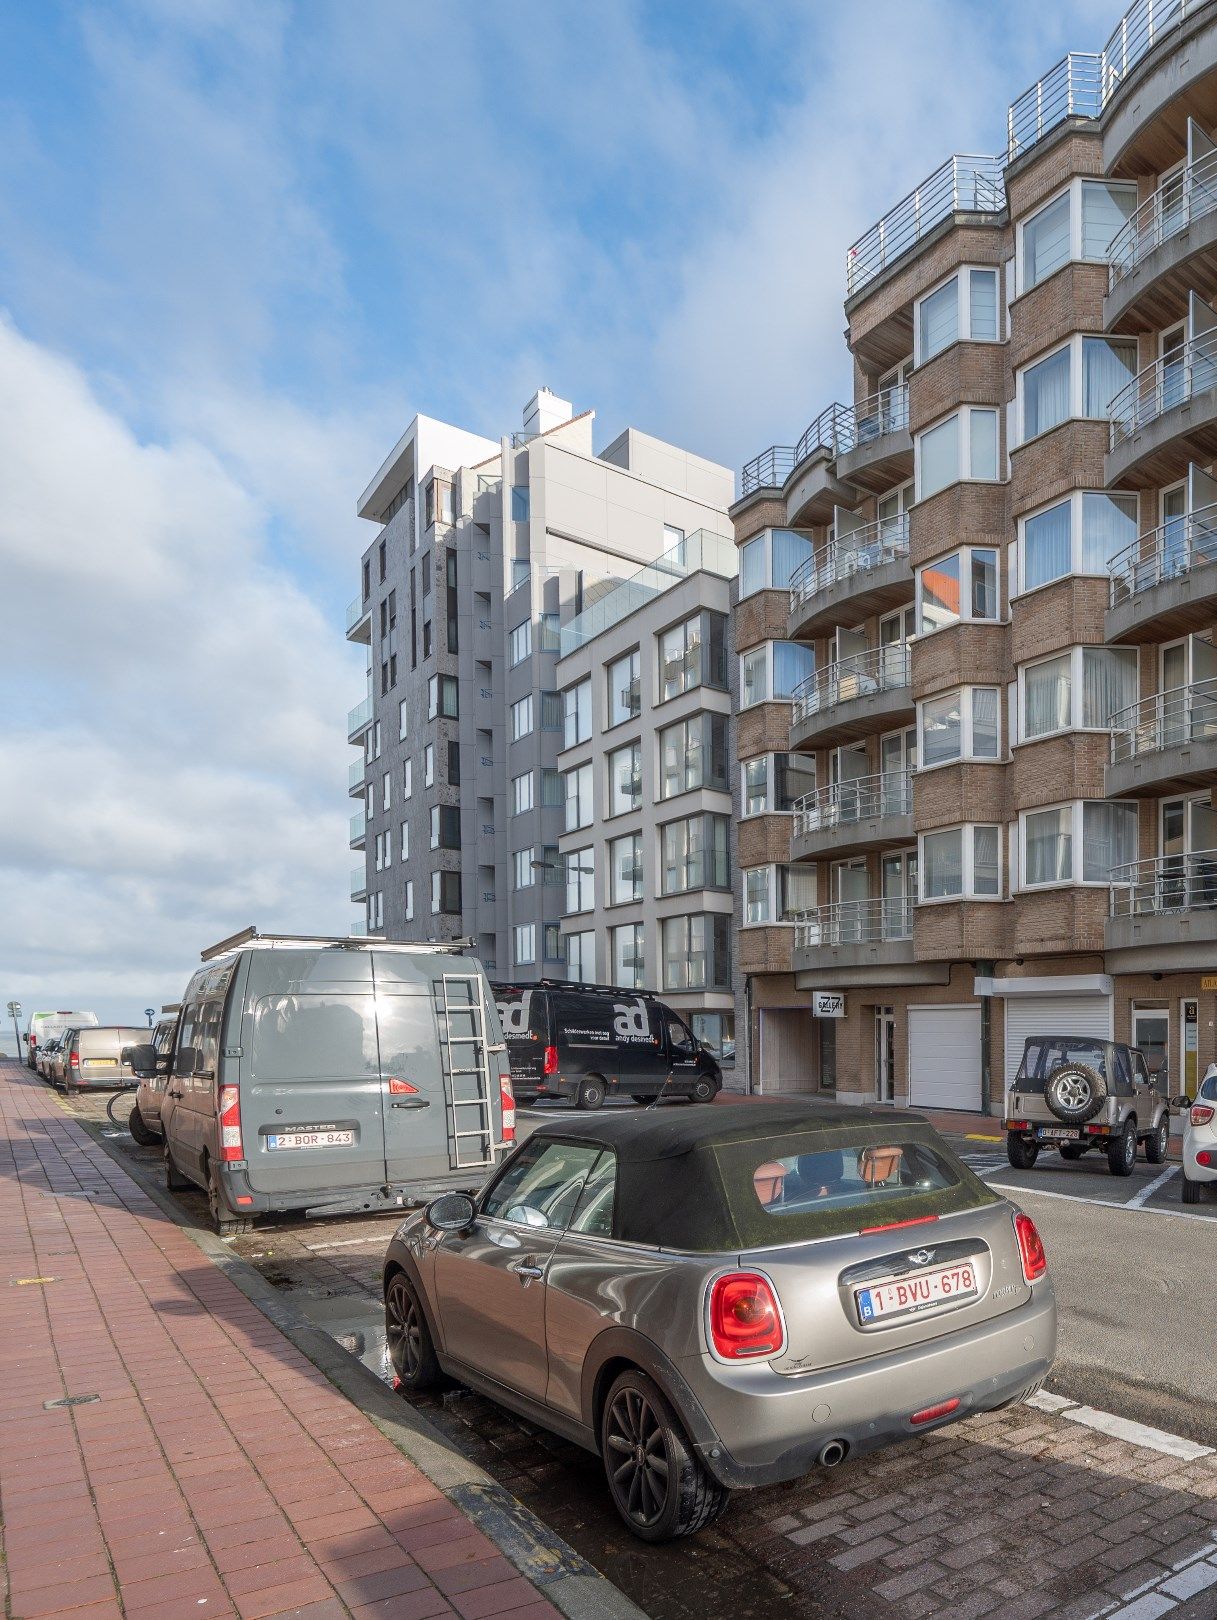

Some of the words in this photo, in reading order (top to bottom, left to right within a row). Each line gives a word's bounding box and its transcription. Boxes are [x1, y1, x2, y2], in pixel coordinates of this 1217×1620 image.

[613, 998, 650, 1036] ad
[615, 1035, 630, 1043] andy
[285, 1124, 336, 1132] MASTER
